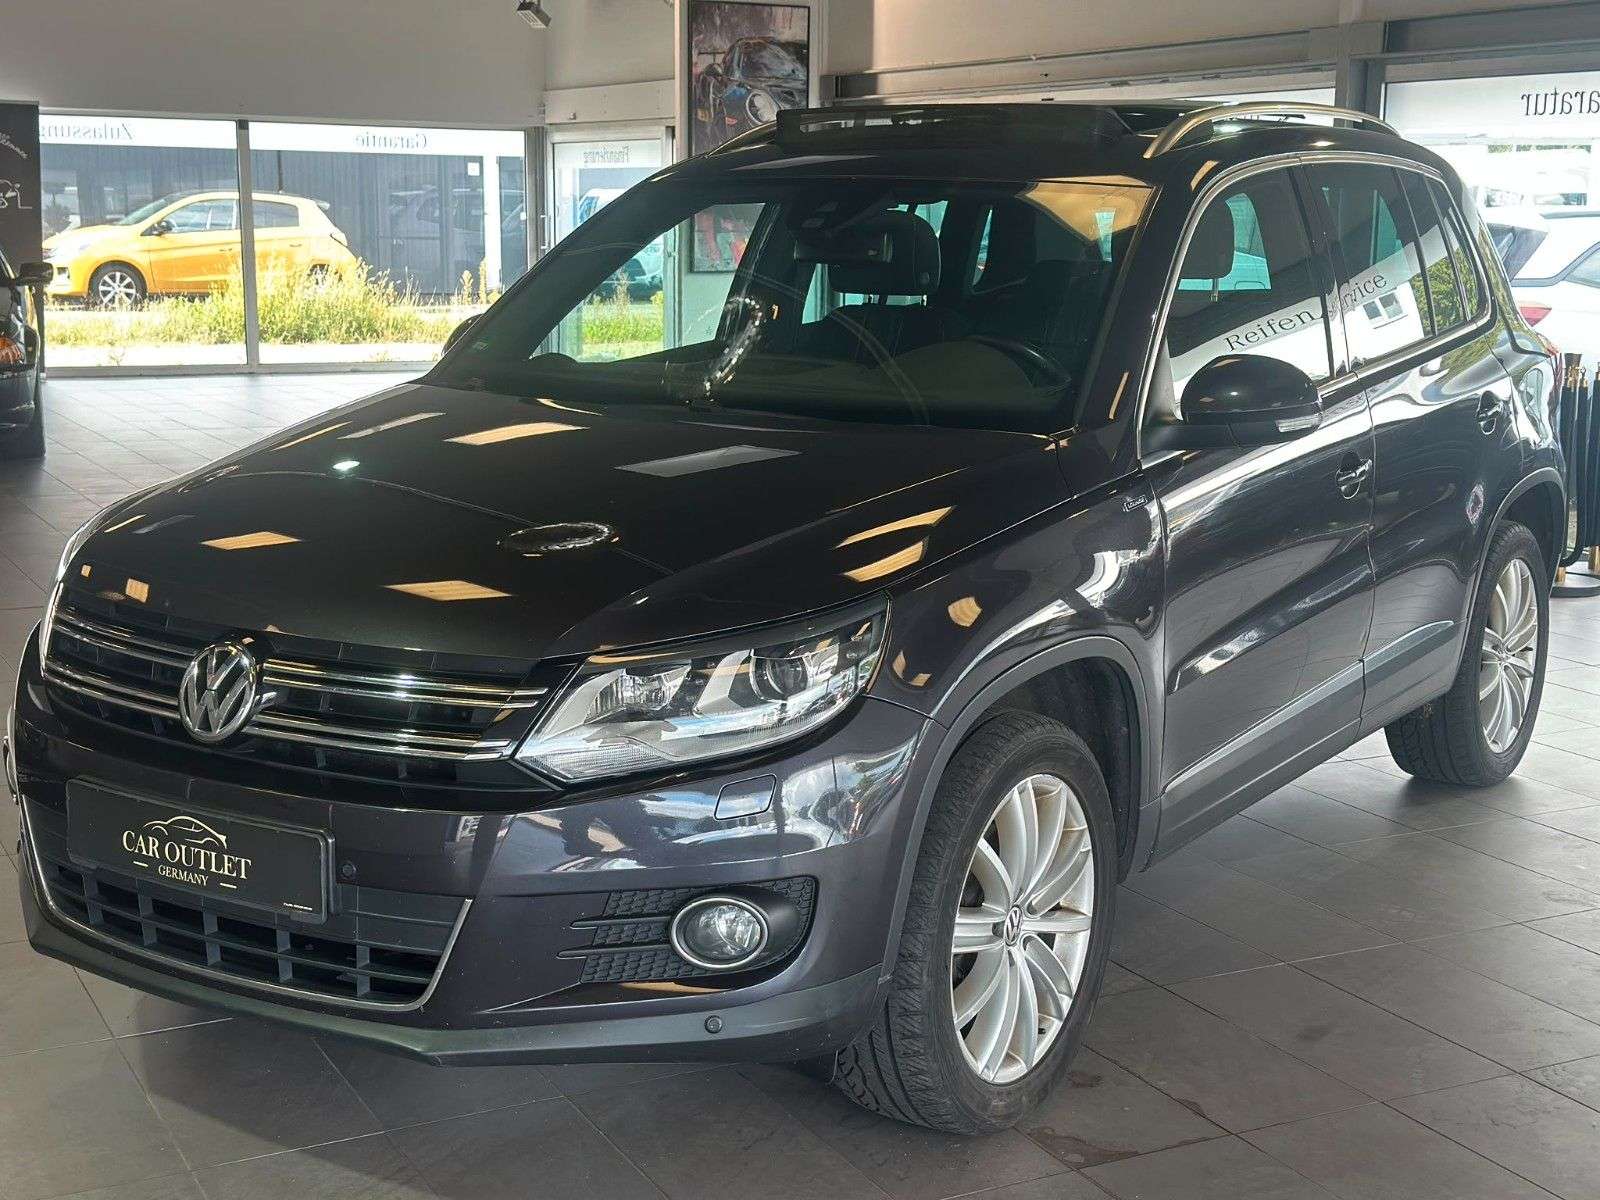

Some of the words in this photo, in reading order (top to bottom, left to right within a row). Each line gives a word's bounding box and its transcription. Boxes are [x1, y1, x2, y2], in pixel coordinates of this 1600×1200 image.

[1225, 310, 1320, 351] Reifen
[123, 830, 160, 859] CAR
[164, 841, 252, 880] OUTLET
[158, 864, 209, 887] GERMANY
